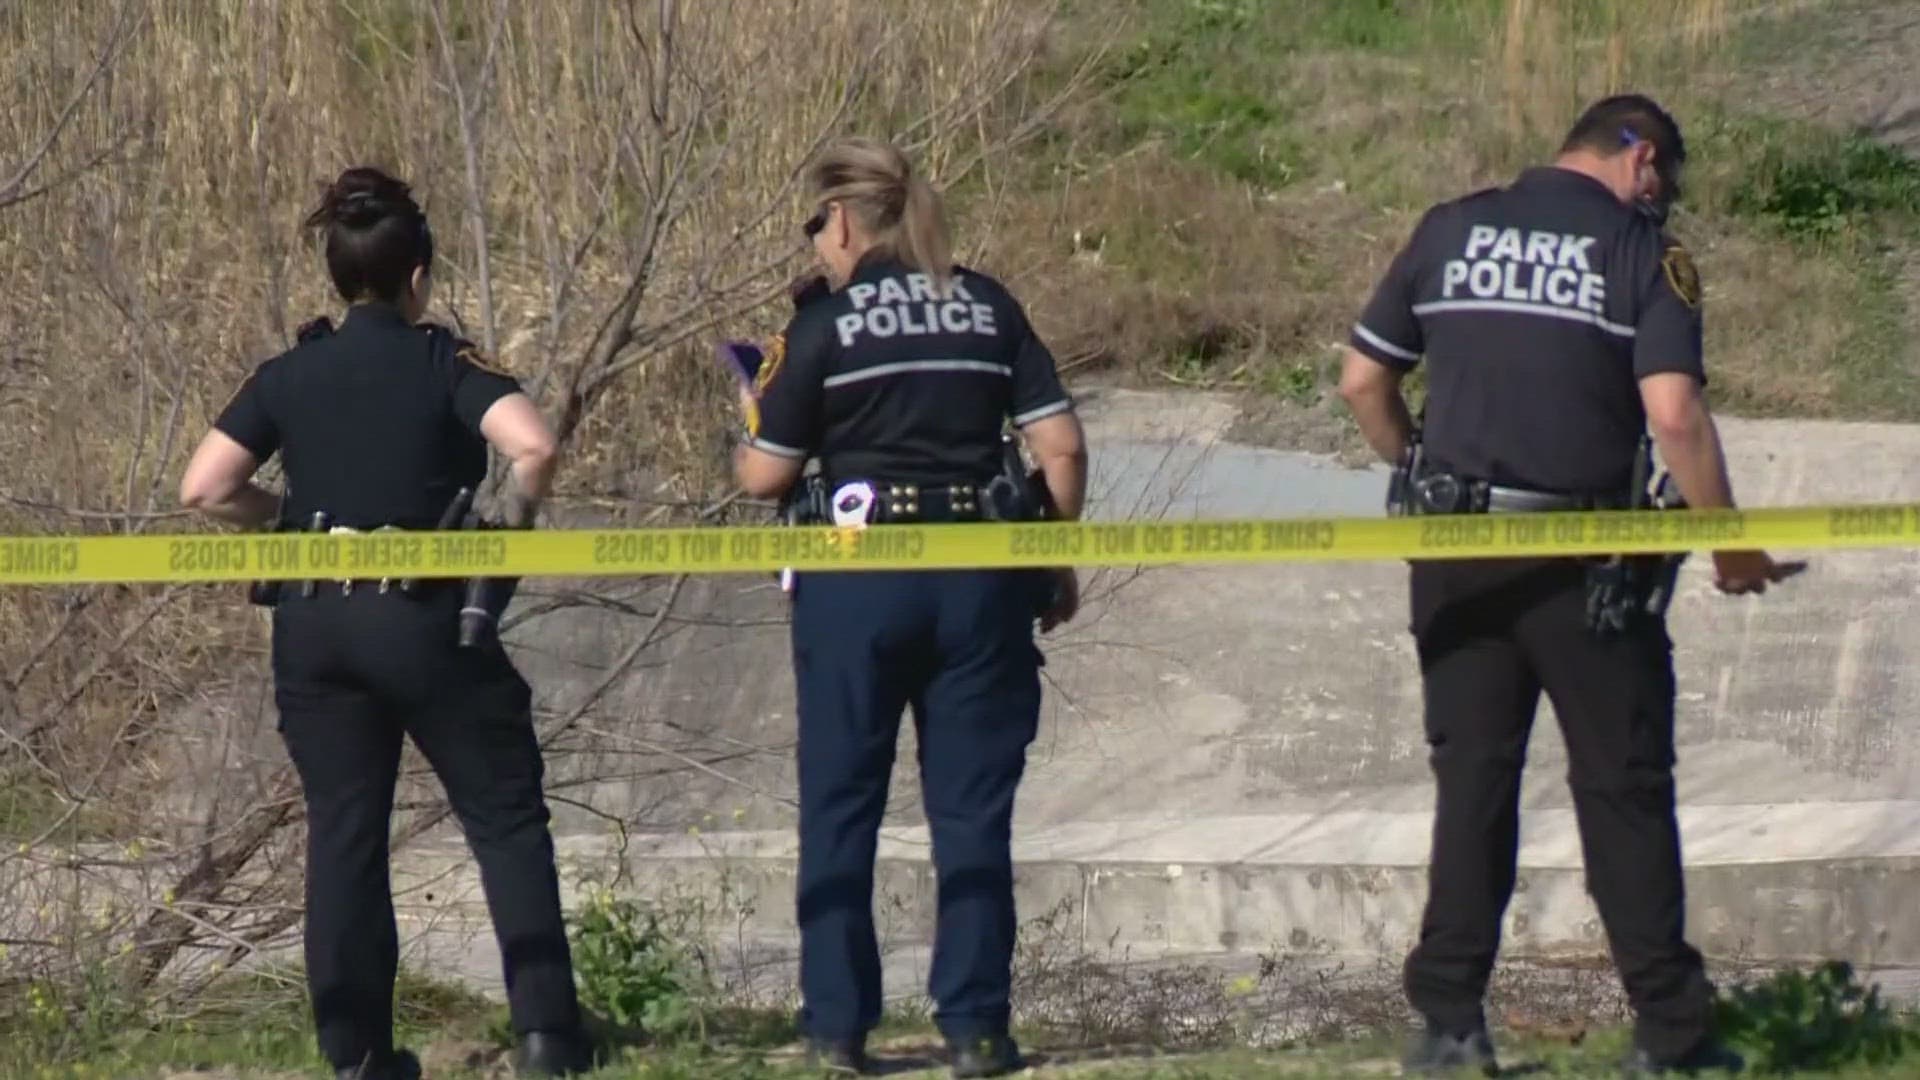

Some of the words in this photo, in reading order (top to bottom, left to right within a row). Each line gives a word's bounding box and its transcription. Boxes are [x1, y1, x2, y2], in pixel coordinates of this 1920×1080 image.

[1465, 224, 1597, 271] PARK
[847, 272, 974, 310] PARK
[1442, 260, 1606, 315] POLICE
[835, 302, 998, 347] POLICE
